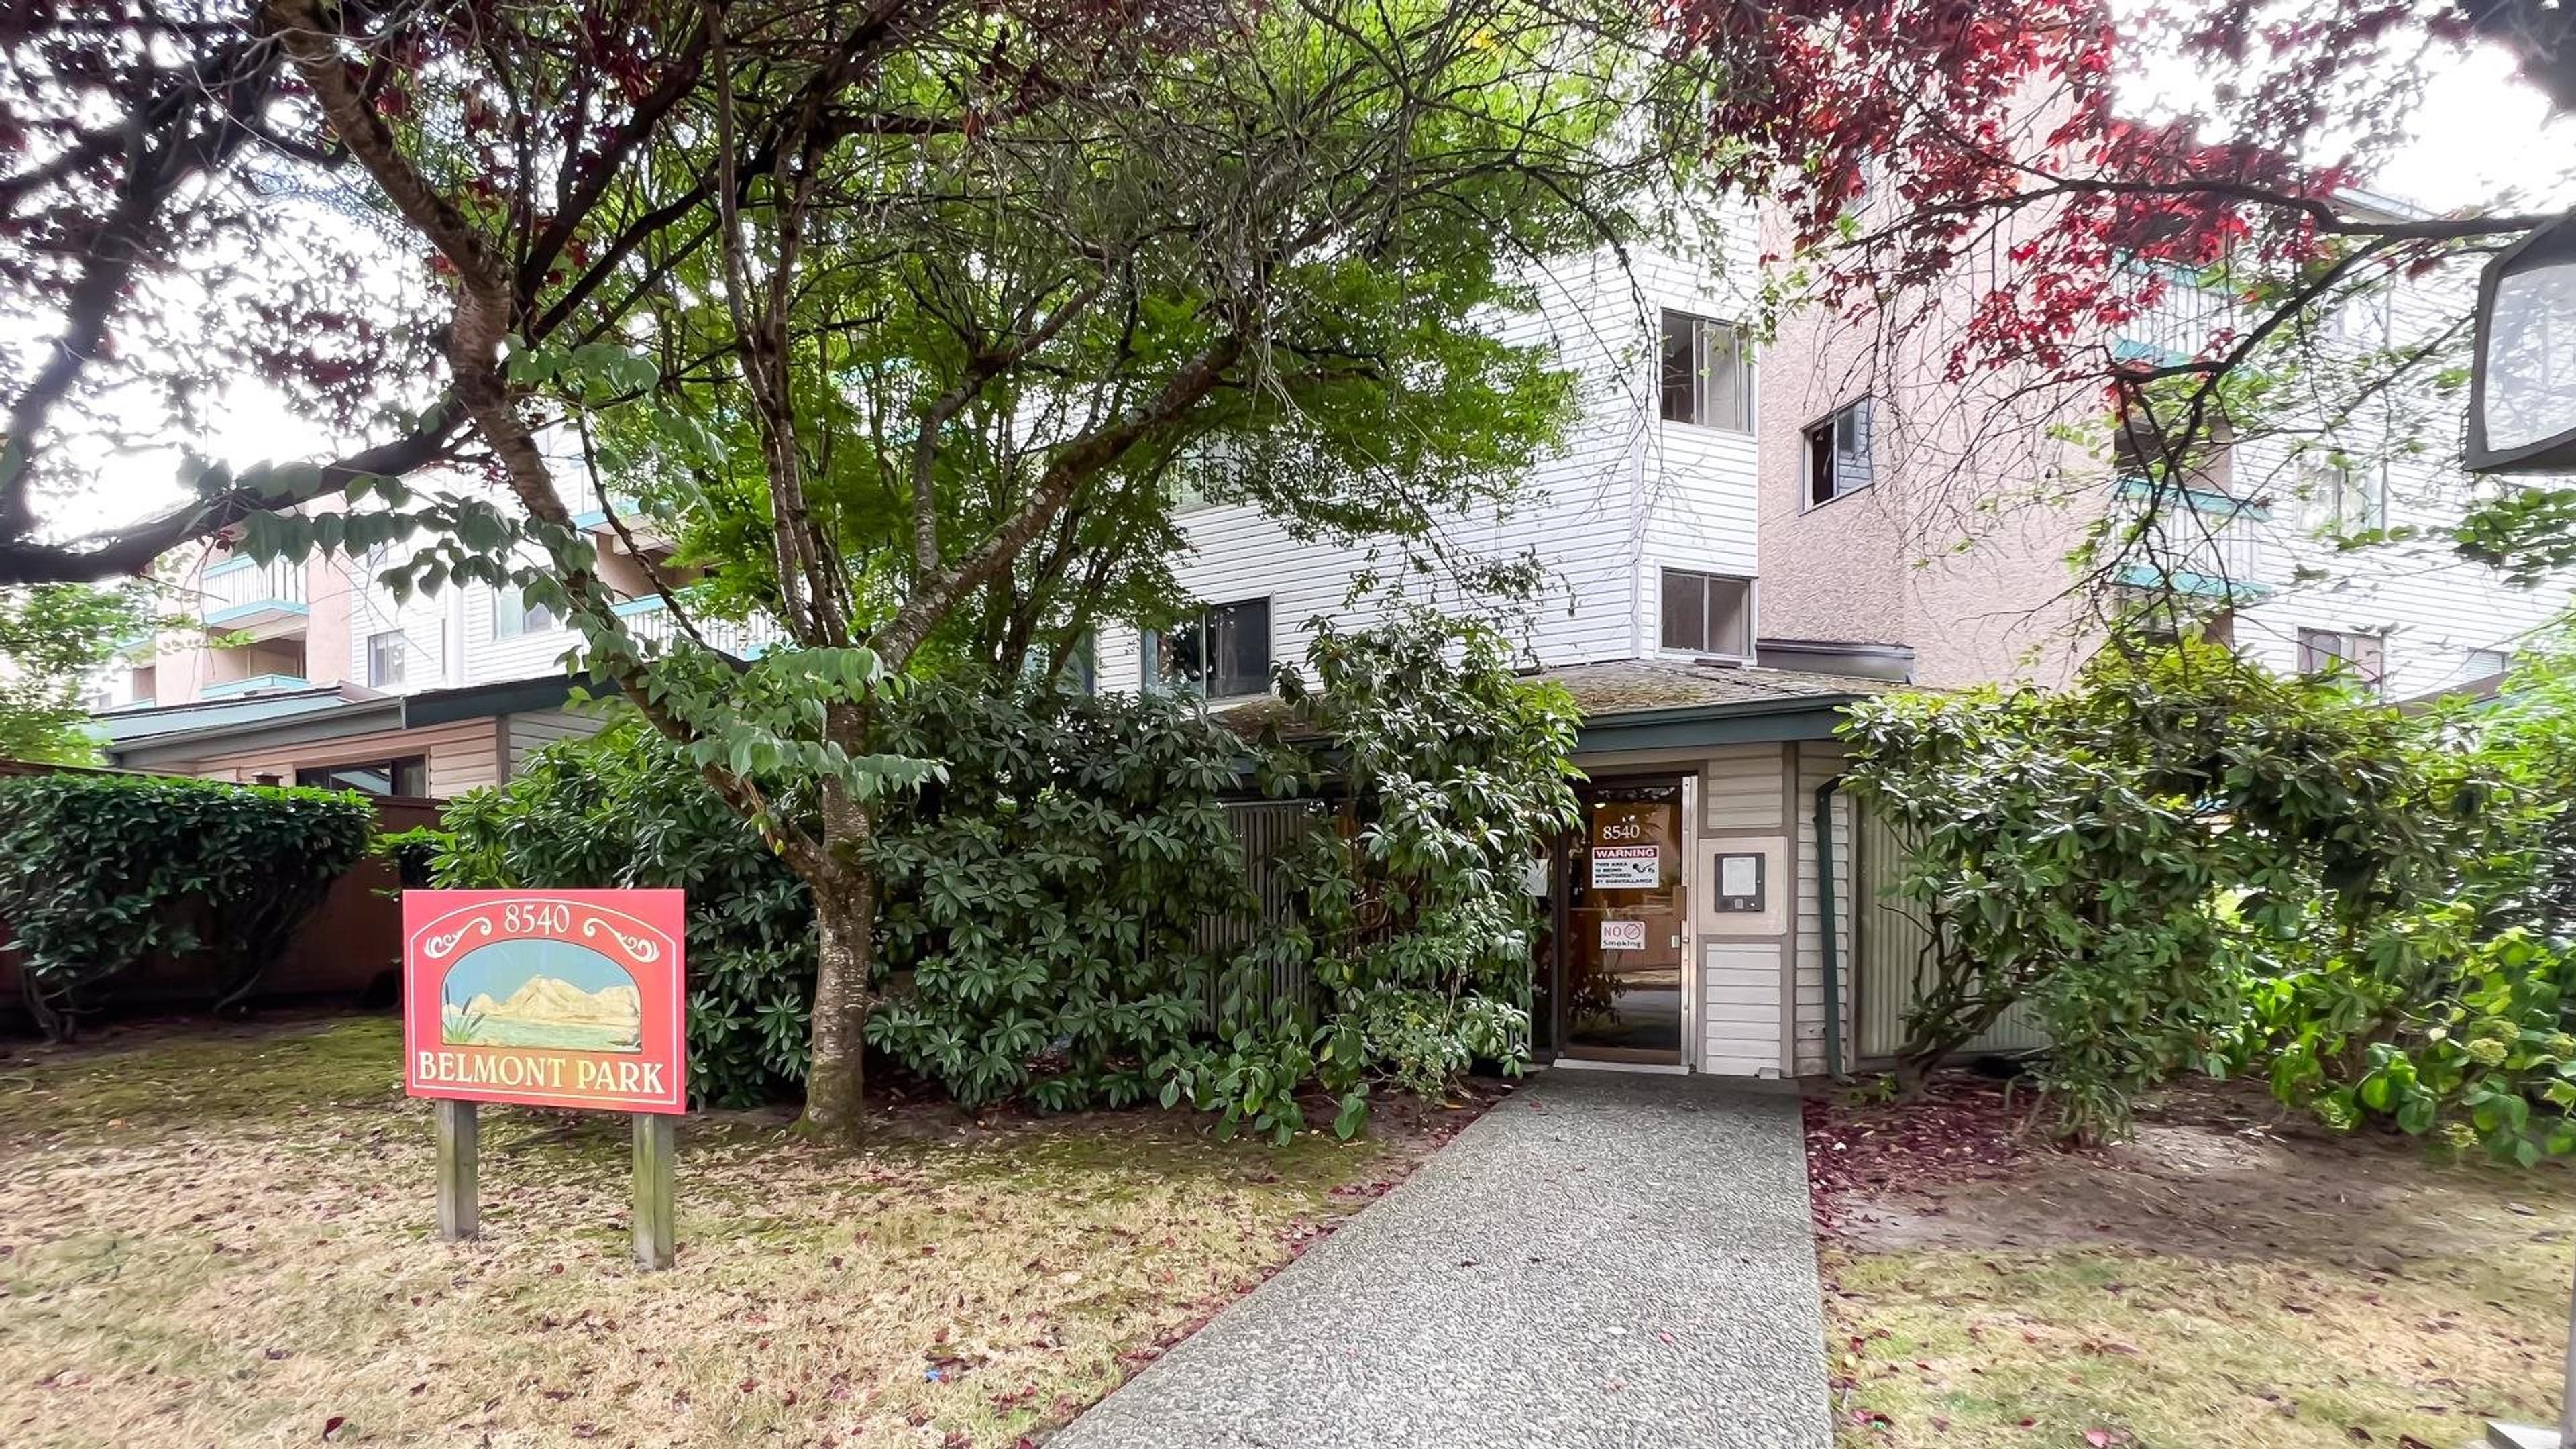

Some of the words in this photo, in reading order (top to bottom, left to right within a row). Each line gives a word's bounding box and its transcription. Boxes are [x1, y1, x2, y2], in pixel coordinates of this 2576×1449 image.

[1603, 825, 1640, 839] 8540
[1596, 849, 1655, 858] WARNING
[505, 904, 570, 935] 8540
[1604, 926, 1621, 937] NO
[1603, 940, 1642, 948] Smoking
[419, 1051, 565, 1087] BELMONT
[576, 1059, 665, 1094] PARK
